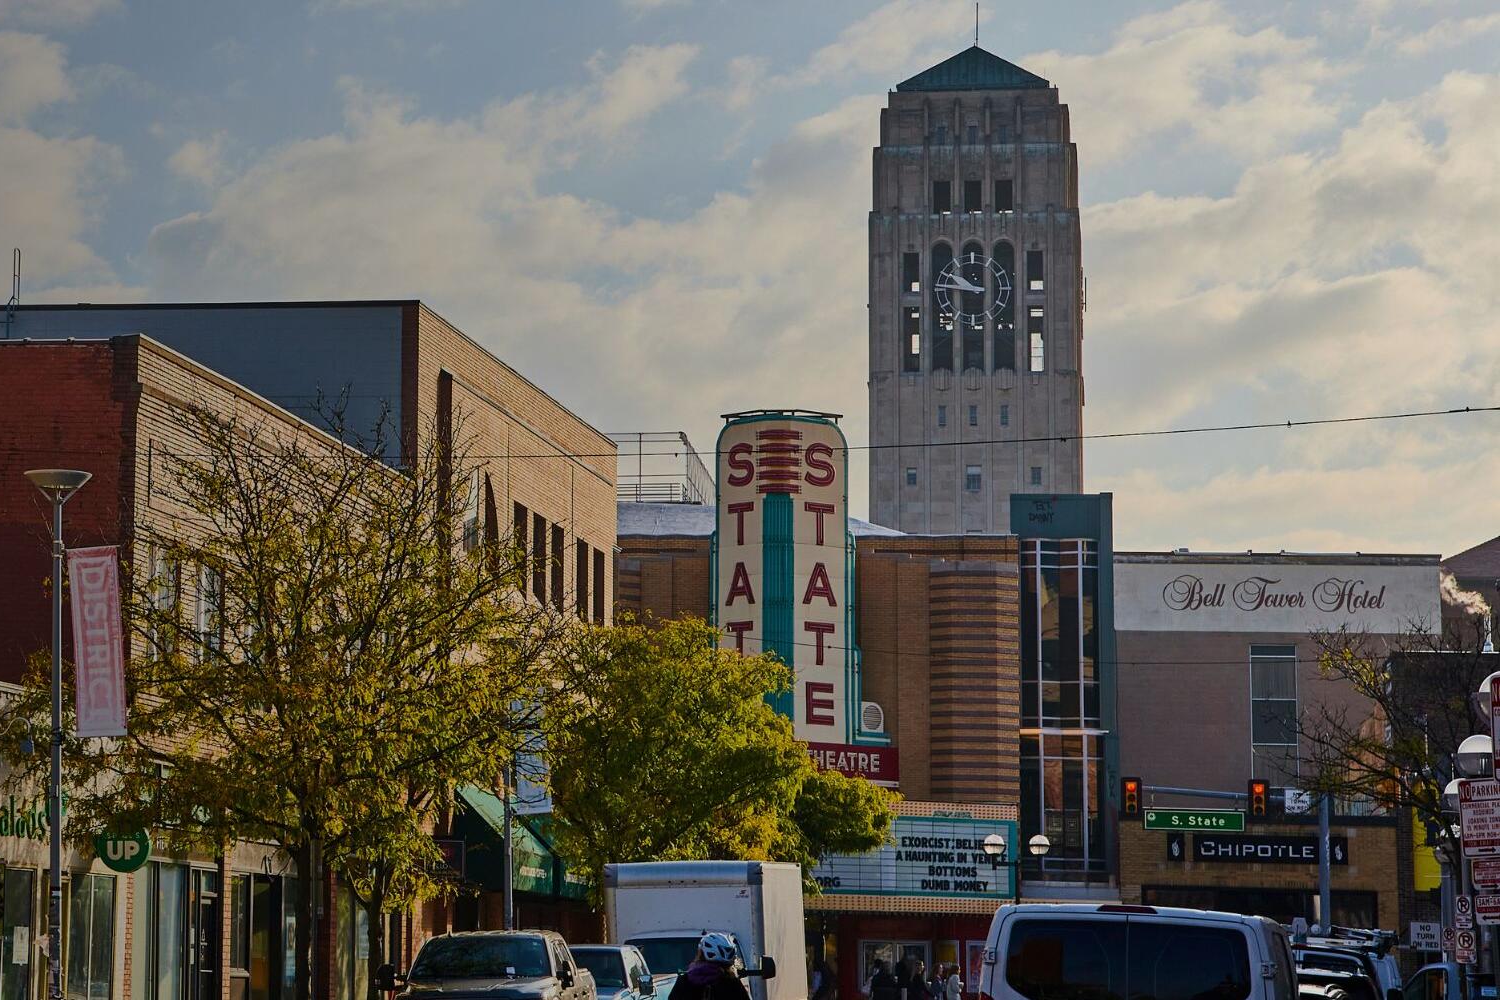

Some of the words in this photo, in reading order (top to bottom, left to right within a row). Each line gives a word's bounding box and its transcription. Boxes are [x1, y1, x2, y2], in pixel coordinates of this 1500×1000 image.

[725, 442, 757, 658] STAT
[803, 442, 837, 725] STATE
[1163, 574, 1225, 611] Bell
[1232, 577, 1306, 611] Tower
[1312, 578, 1386, 613] Hotel
[1460, 784, 1471, 800] NO
[1472, 784, 1500, 797] PARKIN
[1171, 816, 1183, 825] S.
[1188, 816, 1226, 826] State
[107, 840, 141, 861] UP
[896, 851, 903, 861] A
[905, 851, 955, 863] HAUNTING
[957, 852, 967, 863] IN
[1200, 841, 1315, 858] CHIPOTLE
[928, 866, 977, 877] BOTTOMS
[921, 880, 950, 890] DUMB
[954, 881, 989, 892] MONEY
